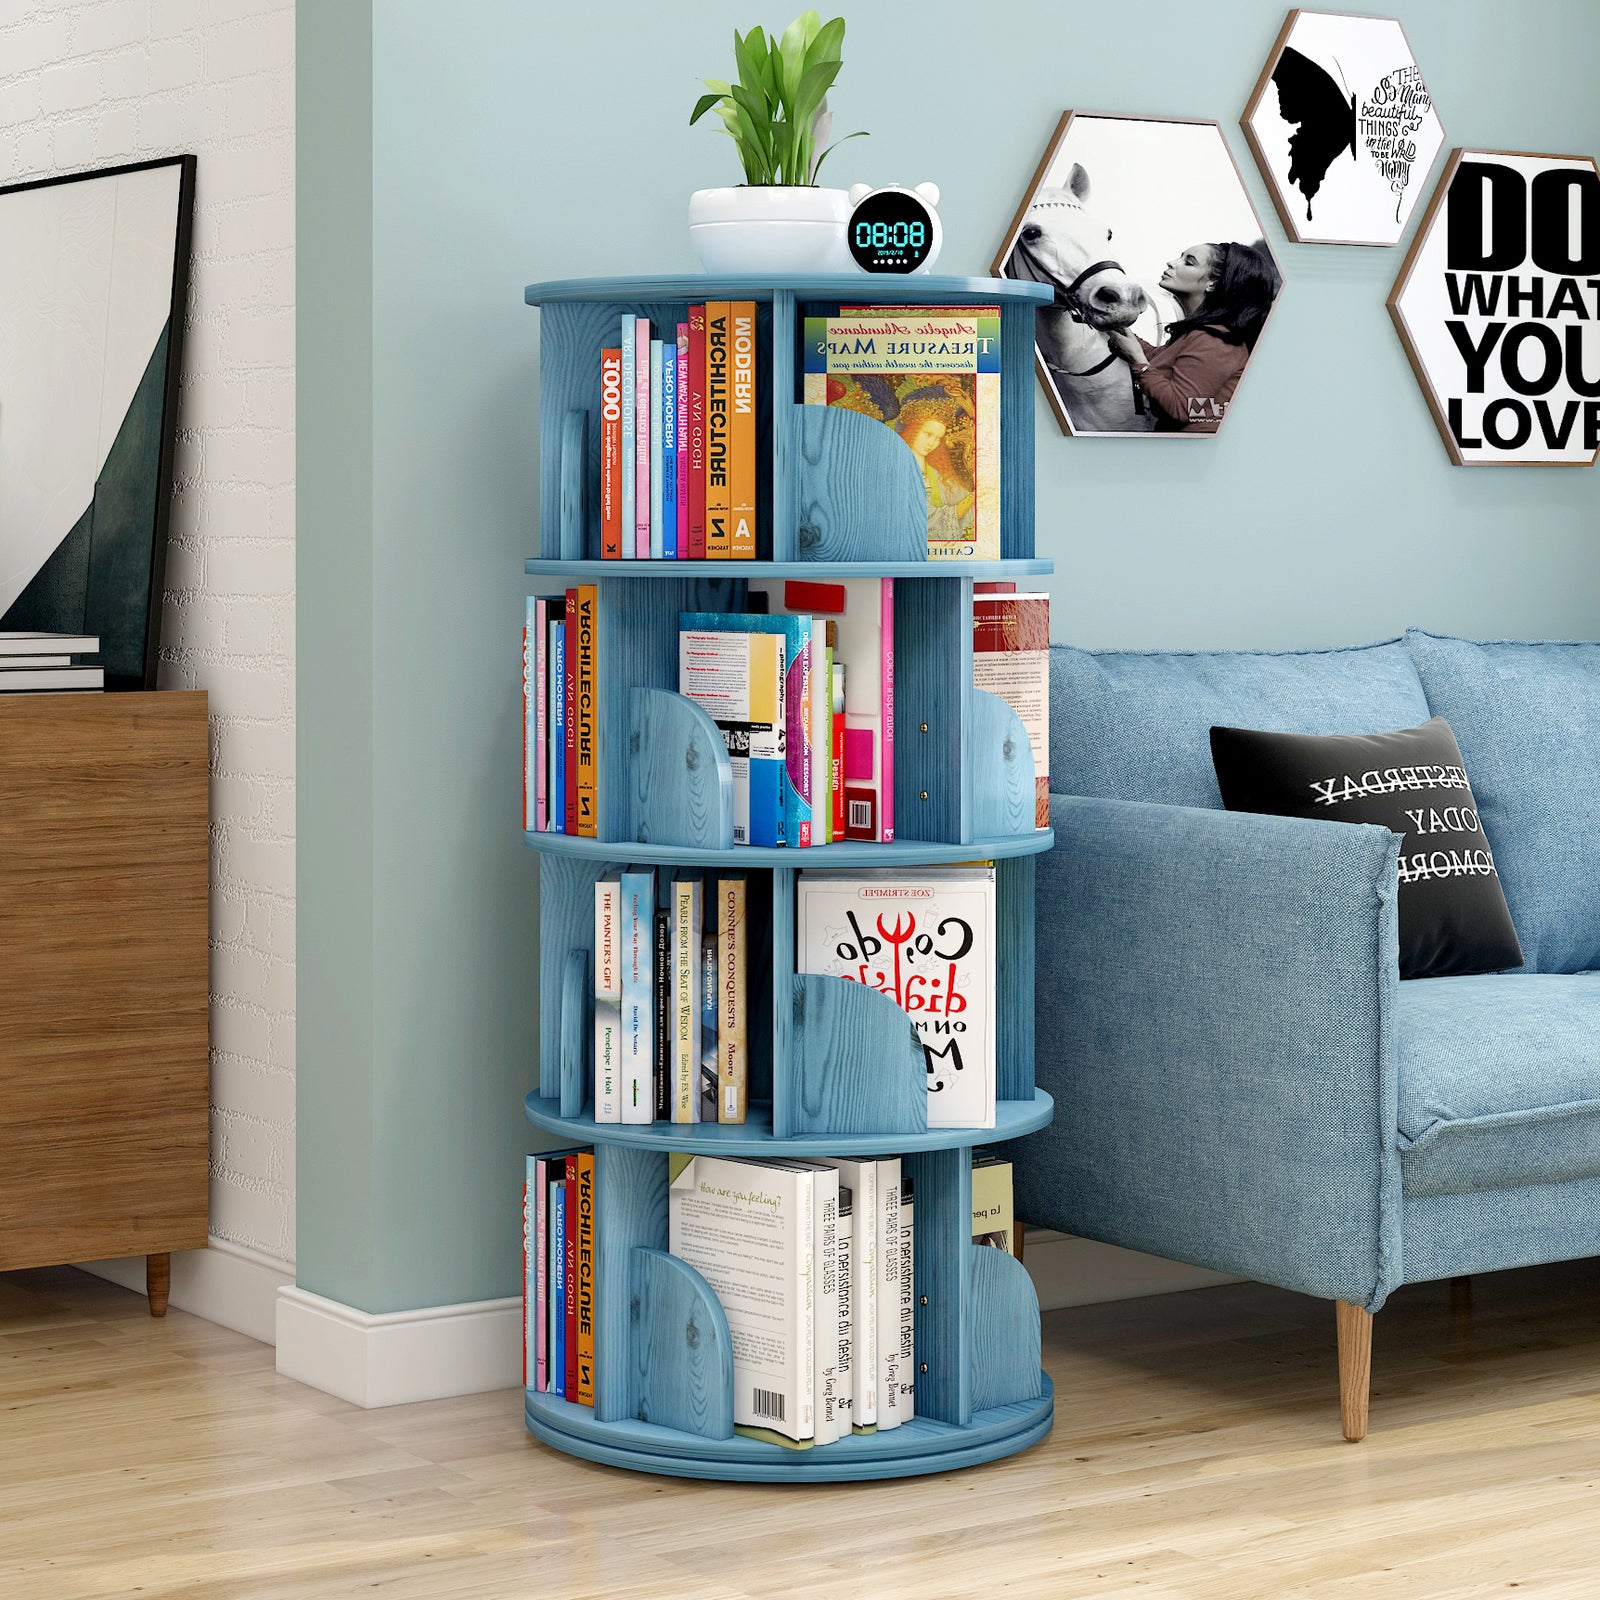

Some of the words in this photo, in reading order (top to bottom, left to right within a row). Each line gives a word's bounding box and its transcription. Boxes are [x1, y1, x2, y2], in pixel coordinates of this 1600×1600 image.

[1392, 65, 1420, 85] THE
[1361, 102, 1419, 125] beautiful
[1358, 118, 1399, 137] THINGS
[1380, 151, 1389, 159] BE
[1447, 161, 1600, 276] DO
[856, 221, 925, 248] 08:08
[1444, 320, 1600, 398] YOU
[886, 651, 894, 687] colour
[885, 688, 894, 742] inspiration
[832, 758, 840, 791] Design
[680, 894, 690, 925] PEARLS
[727, 891, 736, 950] CONNIE'S
[680, 926, 688, 949] FROM
[680, 951, 688, 967] THE
[680, 969, 690, 990] SEAT
[726, 953, 736, 1029] CONQUESTS
[680, 991, 688, 1003] OF
[680, 1005, 691, 1041] WISDOM
[604, 1027, 612, 1066] Penelope
[728, 1043, 736, 1077] Moore
[680, 1074, 688, 1082] by
[681, 1094, 689, 1109] Wise
[699, 1181, 716, 1195] How
[717, 1188, 731, 1197] are
[732, 1191, 747, 1205] you
[747, 1191, 783, 1214] feeling?
[823, 1197, 835, 1222] THREE
[886, 1186, 898, 1211] THREE
[823, 1223, 835, 1247] PAIRS
[886, 1212, 898, 1235] PAIRS
[823, 1248, 835, 1258] OF
[886, 1236, 898, 1246] OF
[823, 1260, 835, 1295] GLASSES
[886, 1248, 898, 1283] GLASSES
[901, 1325, 914, 1359] destin
[839, 1339, 852, 1373] destin
[885, 1353, 899, 1363] by
[822, 1367, 837, 1377] by
[885, 1364, 899, 1382] Greg
[823, 1378, 837, 1396] Greg
[889, 1383, 899, 1408] Bennet
[826, 1397, 836, 1422] Bennet
